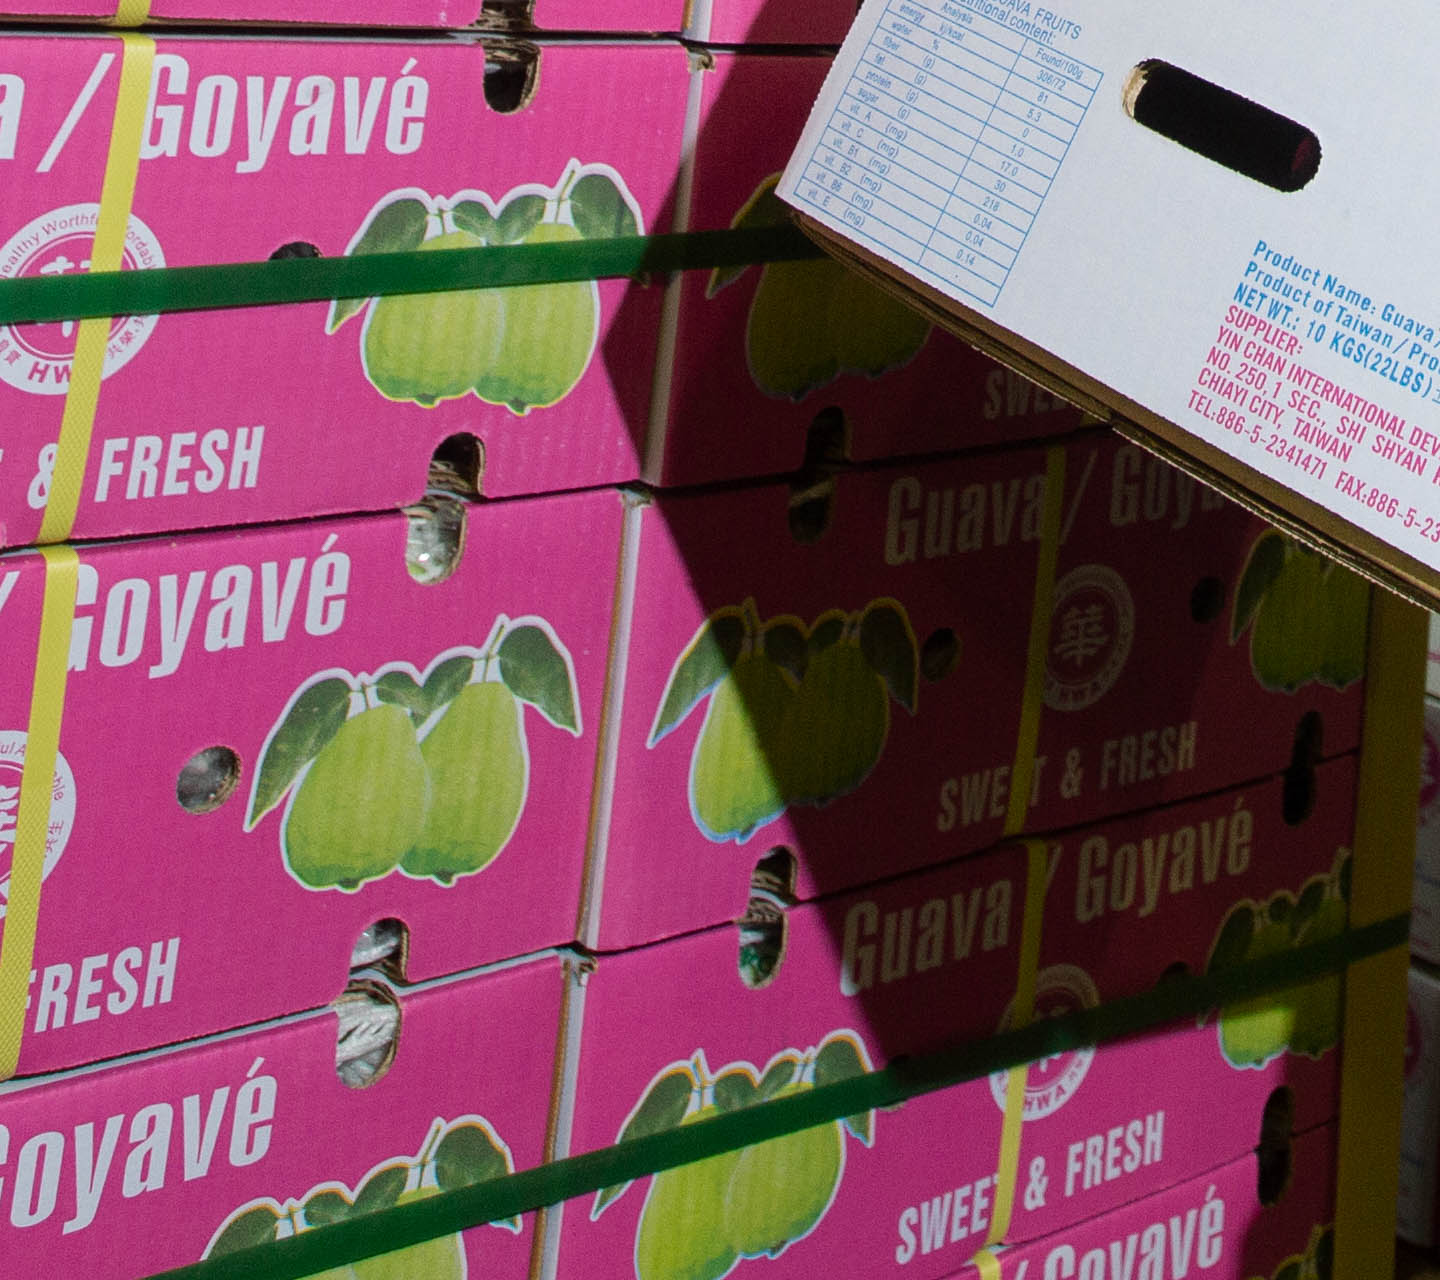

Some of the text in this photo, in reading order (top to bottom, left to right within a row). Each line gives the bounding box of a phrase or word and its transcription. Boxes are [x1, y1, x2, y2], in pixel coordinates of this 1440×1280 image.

[941, 2, 973, 25] Analysis
[1010, 11, 1056, 46] content:
[1034, 7, 1082, 40] FRUITS
[866, 70, 892, 90] protein
[1035, 48, 1084, 80] Found/100g
[1037, 91, 1049, 104] 81
[139, 53, 429, 173] Goyavé
[1027, 108, 1043, 122] 5.3
[994, 179, 1007, 192] 30
[1000, 160, 1019, 177] 17.0
[1010, 143, 1025, 158] 1.0
[1233, 282, 1268, 312] NET
[1306, 319, 1326, 343] 10
[1244, 260, 1311, 308] Product
[1313, 299, 1334, 317] of
[1335, 305, 1393, 349] Taiwan
[1253, 240, 1321, 287] Product
[1322, 274, 1376, 315] Name:
[1381, 303, 1435, 343] Guava
[1225, 305, 1303, 357] SUPPLIER:
[1198, 367, 1353, 464] CHIAYI CITY, TAIWAN
[1206, 345, 1231, 374] NO.
[1234, 362, 1267, 396] 250,
[1272, 381, 1283, 399] 1
[1287, 390, 1326, 428] SEC.,
[1336, 415, 1367, 444] SHI
[1371, 434, 1428, 477] SHYAN
[1216, 325, 1244, 353] YIN
[1243, 340, 1288, 376] CHAN
[1287, 363, 1407, 441] INTERNATIONAL
[27, 443, 58, 509] &
[96, 426, 264, 502] FRESH
[1187, 389, 1328, 480] TEL:886-5-2341471
[884, 476, 1044, 565] Guava
[936, 721, 1198, 833] SWET & FRESH
[840, 797, 1253, 996] Guava Goyavé
[896, 1111, 1164, 1264] SWEE & FRESH
